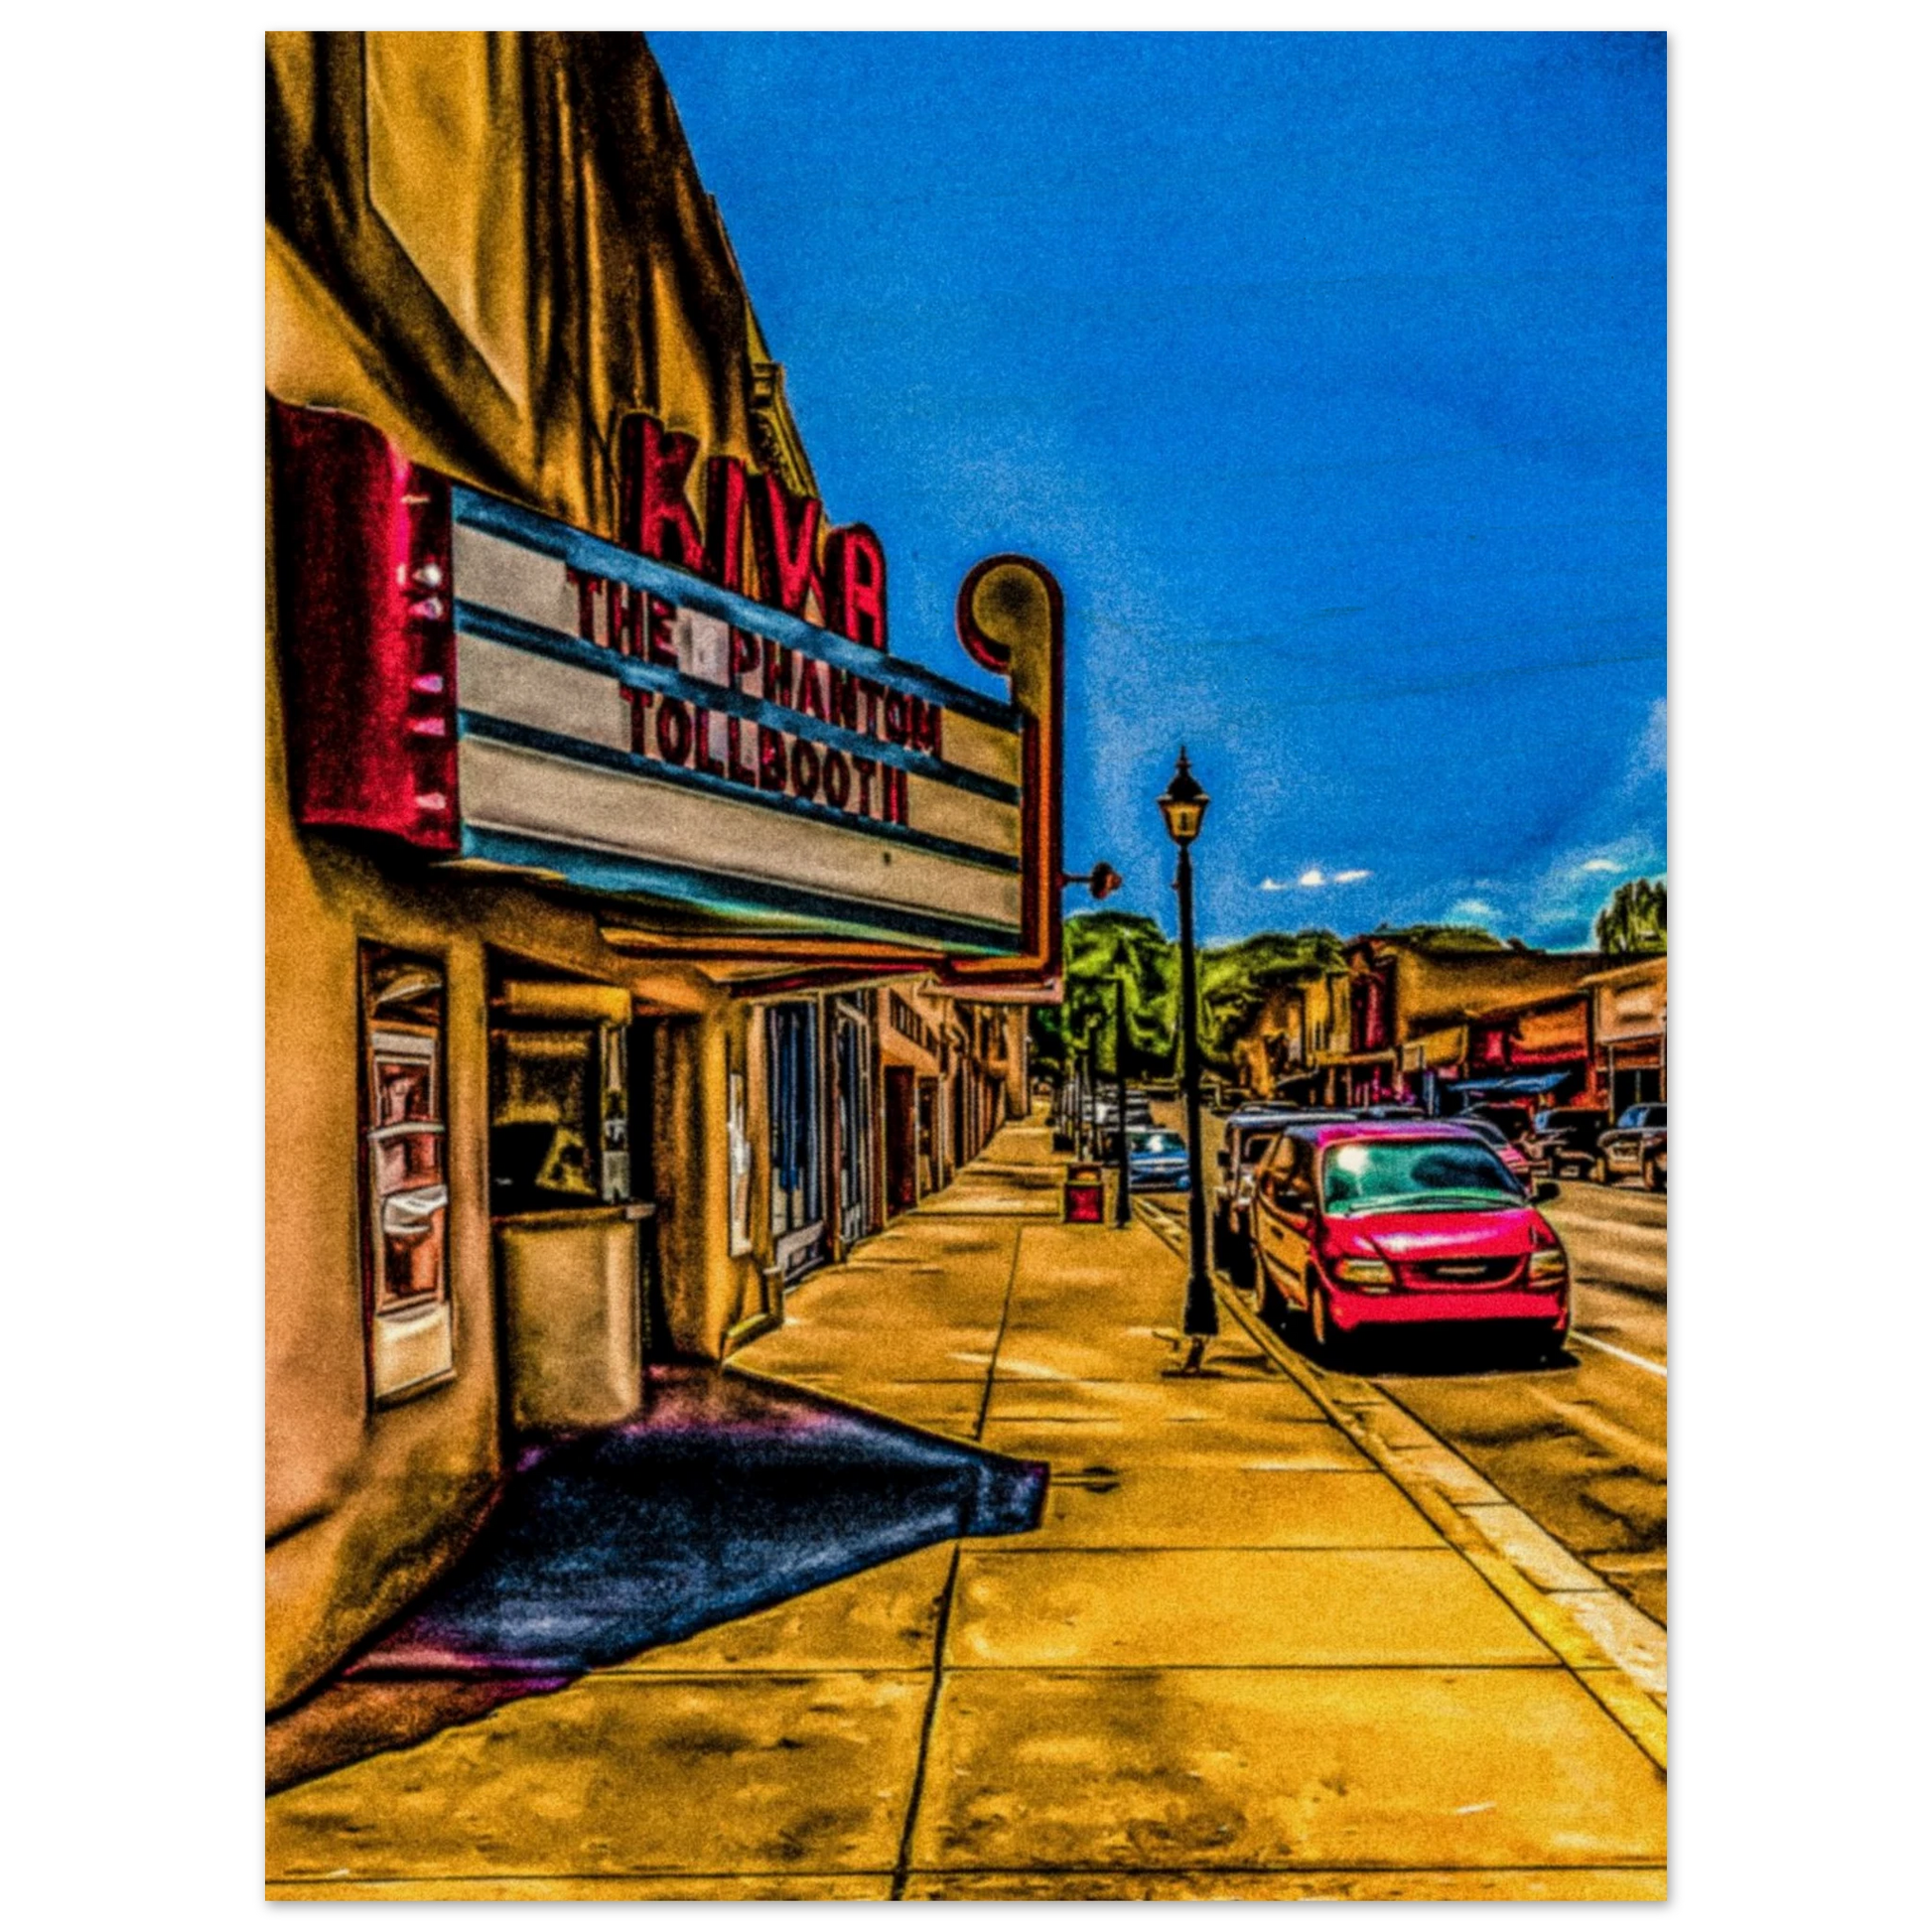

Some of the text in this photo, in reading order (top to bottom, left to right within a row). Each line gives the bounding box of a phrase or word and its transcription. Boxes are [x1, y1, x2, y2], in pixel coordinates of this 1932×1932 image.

[619, 412, 888, 651] KIVA
[567, 567, 942, 759] THE PHANTOM
[620, 678, 909, 827] TOLLBOOTH
